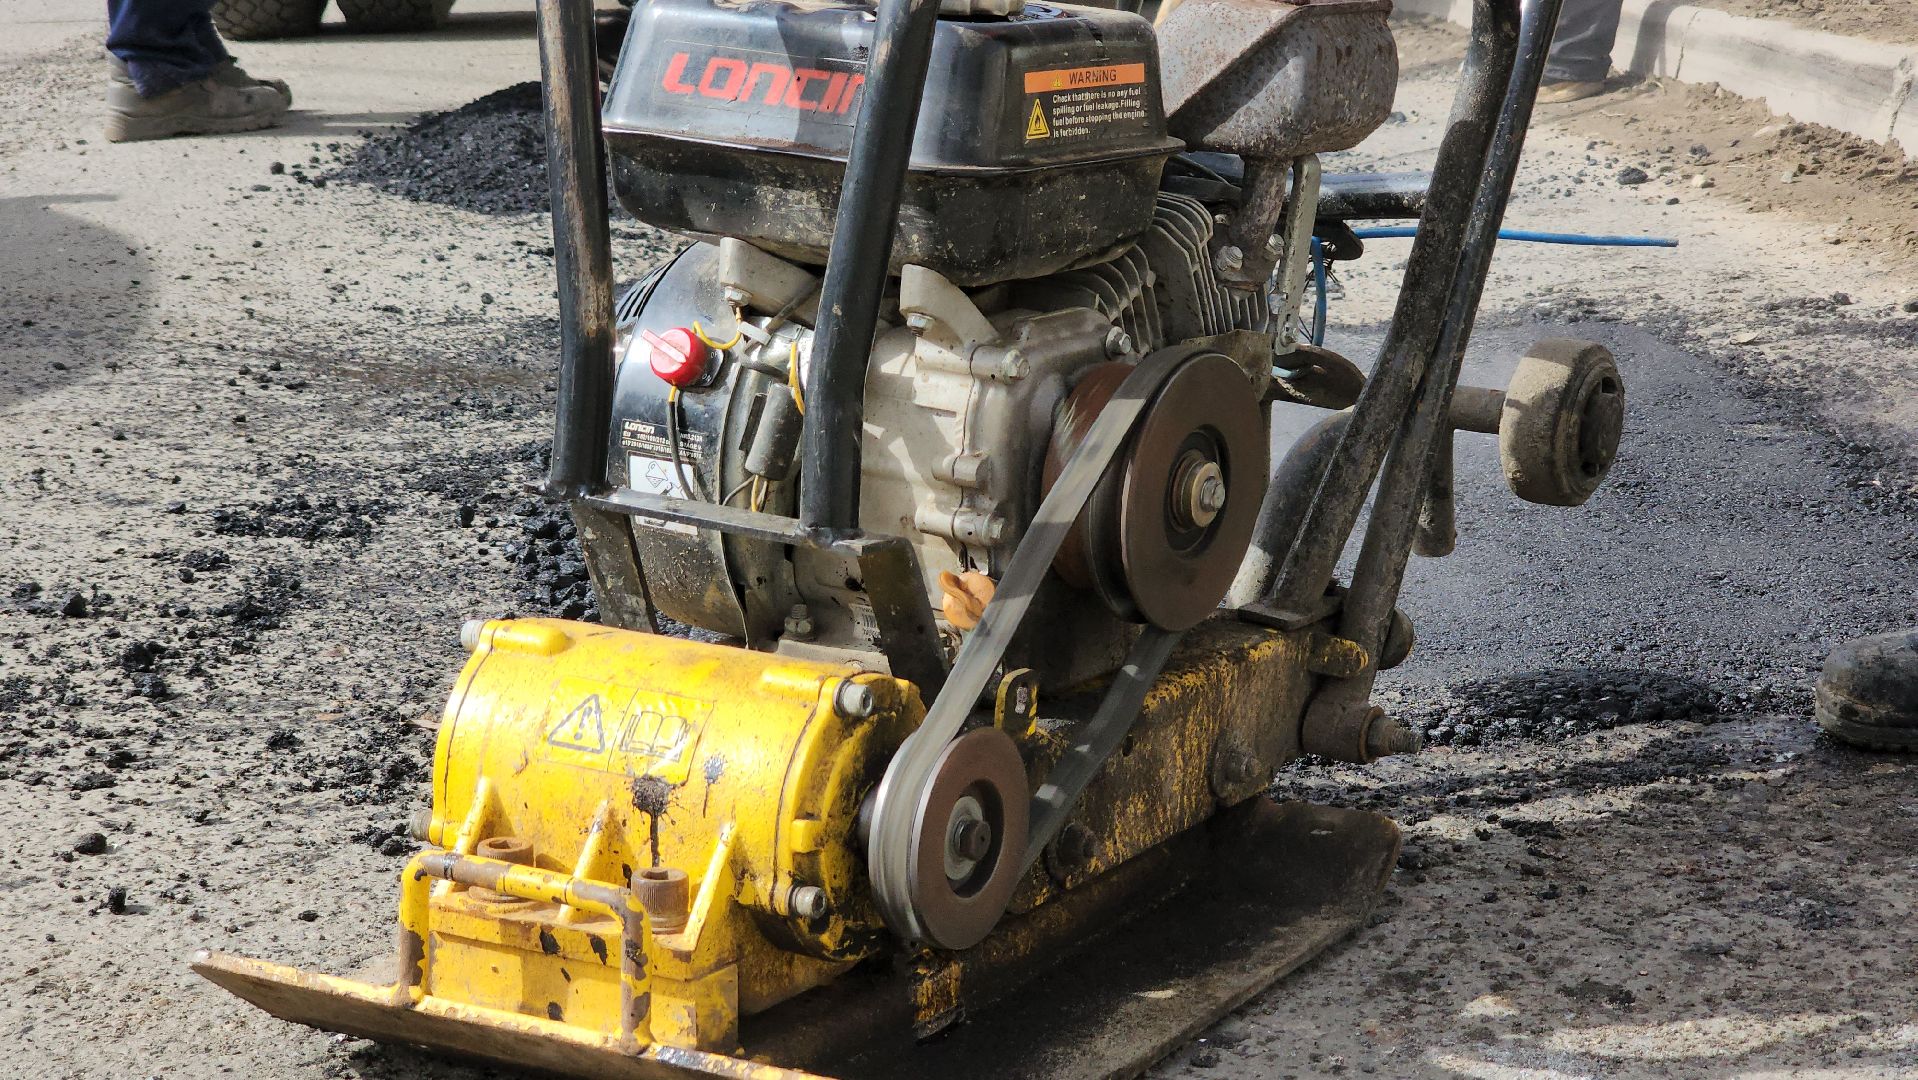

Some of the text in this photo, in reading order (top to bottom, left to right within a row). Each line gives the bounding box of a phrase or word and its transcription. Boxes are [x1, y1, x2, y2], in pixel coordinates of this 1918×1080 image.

[1069, 69, 1117, 84] WARNING
[1052, 87, 1141, 104] Check that there is no any fuel
[1052, 105, 1075, 117] spilling
[1075, 105, 1083, 113] or
[1083, 102, 1095, 112] fuel
[1052, 109, 1145, 127] fuel before stopping the engine
[1053, 126, 1091, 139] is forbidden.
